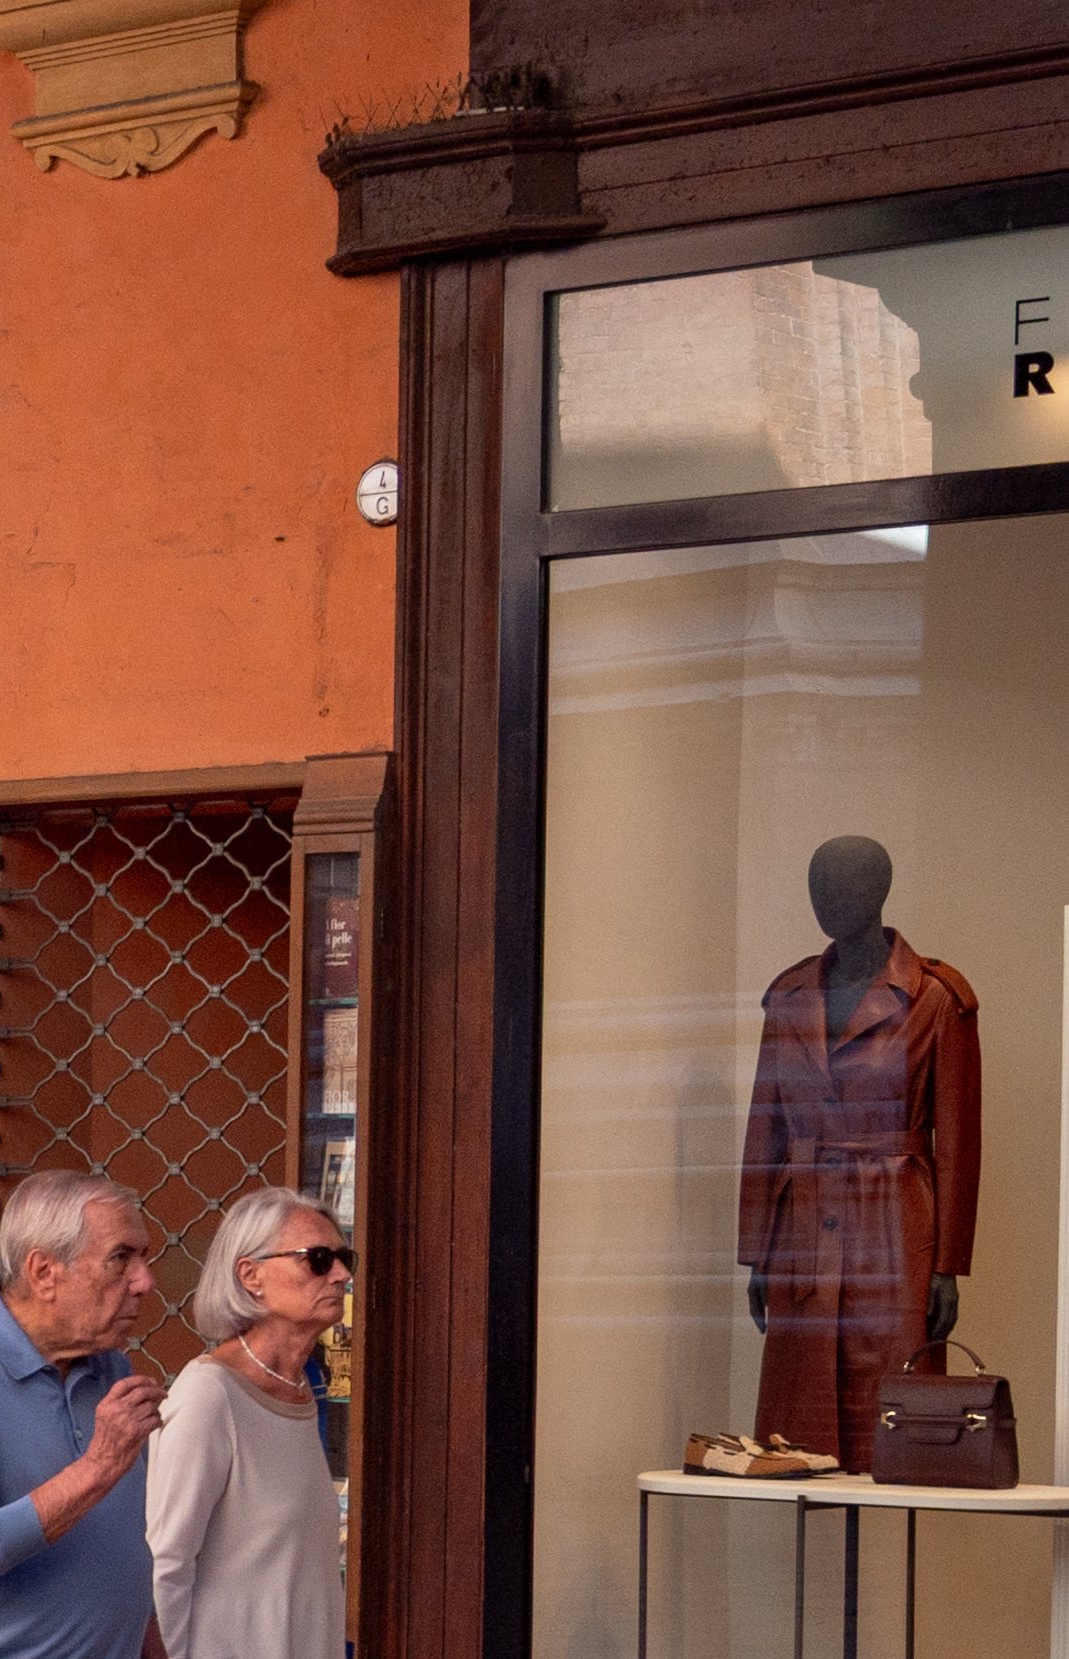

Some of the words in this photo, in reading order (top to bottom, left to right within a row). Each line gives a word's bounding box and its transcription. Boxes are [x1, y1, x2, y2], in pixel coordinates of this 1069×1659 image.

[1015, 296, 1050, 345] F
[1013, 351, 1055, 398] R
[379, 470, 387, 489] 4
[376, 496, 389, 515] G
